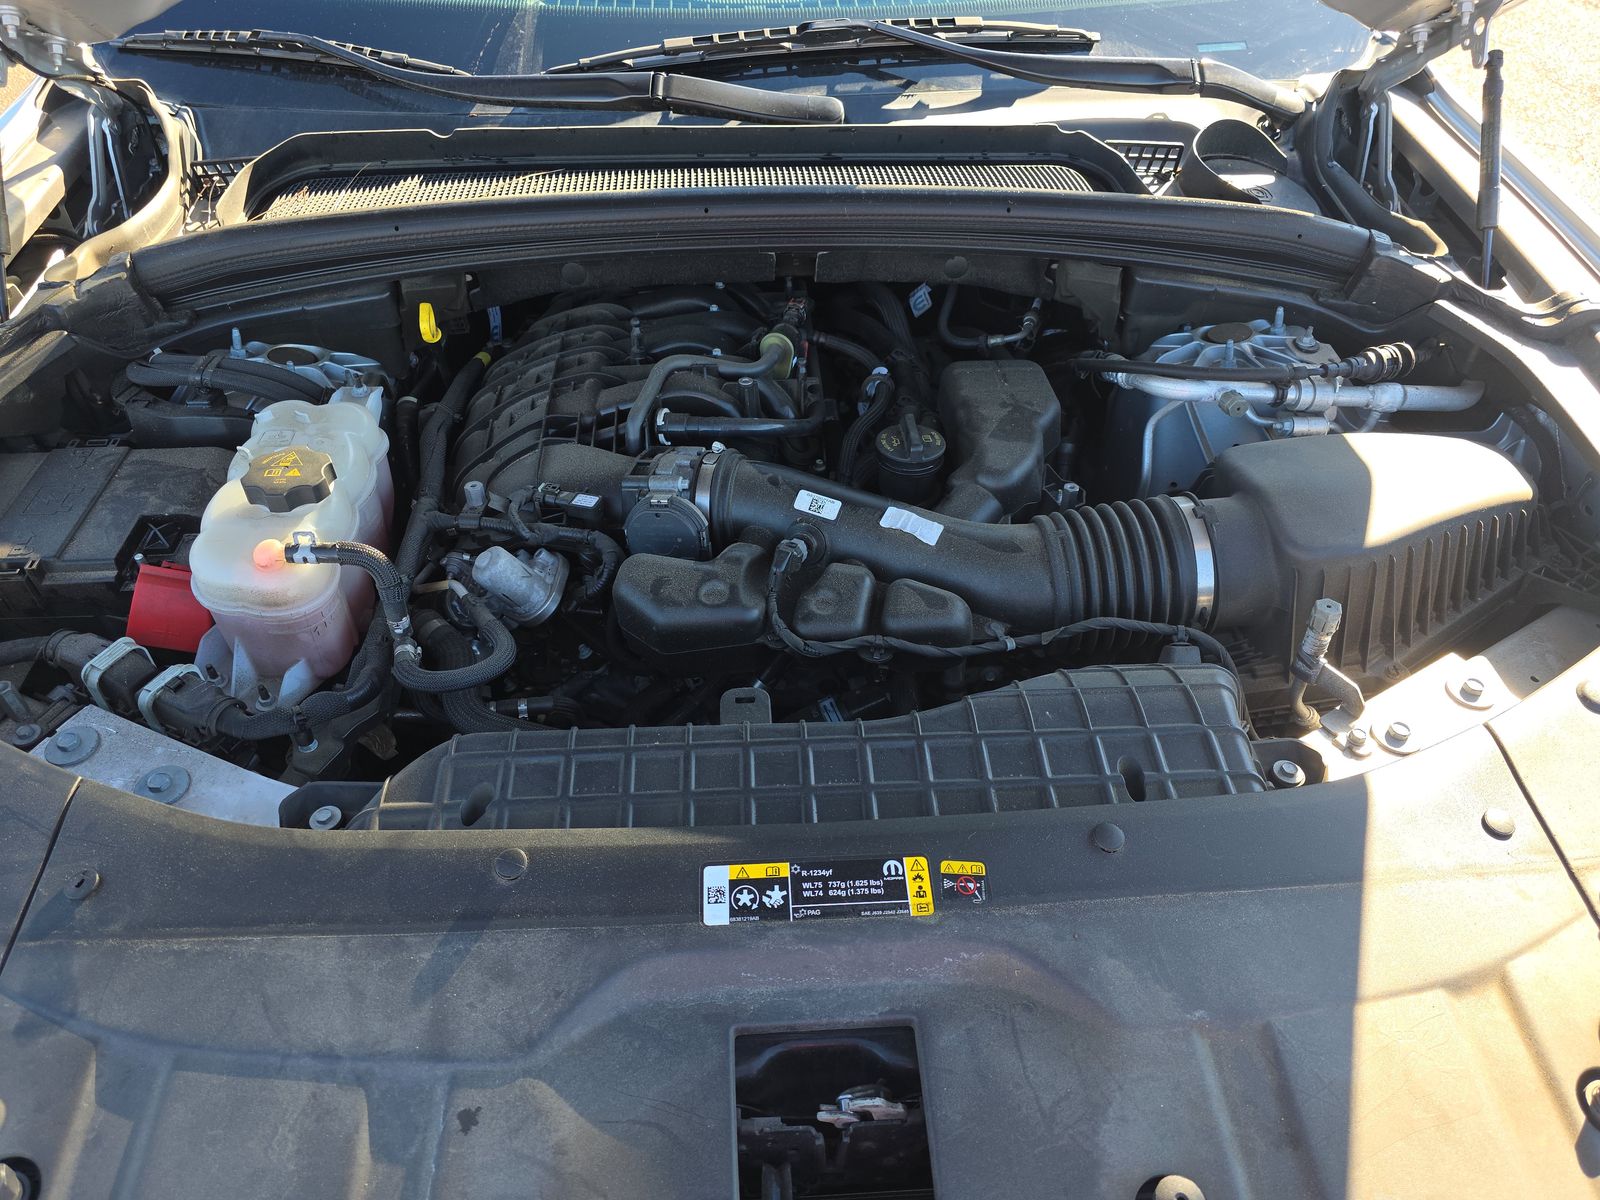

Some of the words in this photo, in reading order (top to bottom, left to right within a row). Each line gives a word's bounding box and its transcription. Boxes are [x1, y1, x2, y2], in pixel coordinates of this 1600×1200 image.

[801, 869, 833, 878] R-1234yf
[802, 881, 823, 889] WL75
[828, 880, 846, 889] 737g
[847, 880, 869, 888] (1.625
[870, 879, 884, 887] lbs)
[802, 889, 824, 897] WL74
[828, 889, 846, 897] 624g
[847, 888, 870, 896] (1.375
[870, 887, 884, 895] lbs)
